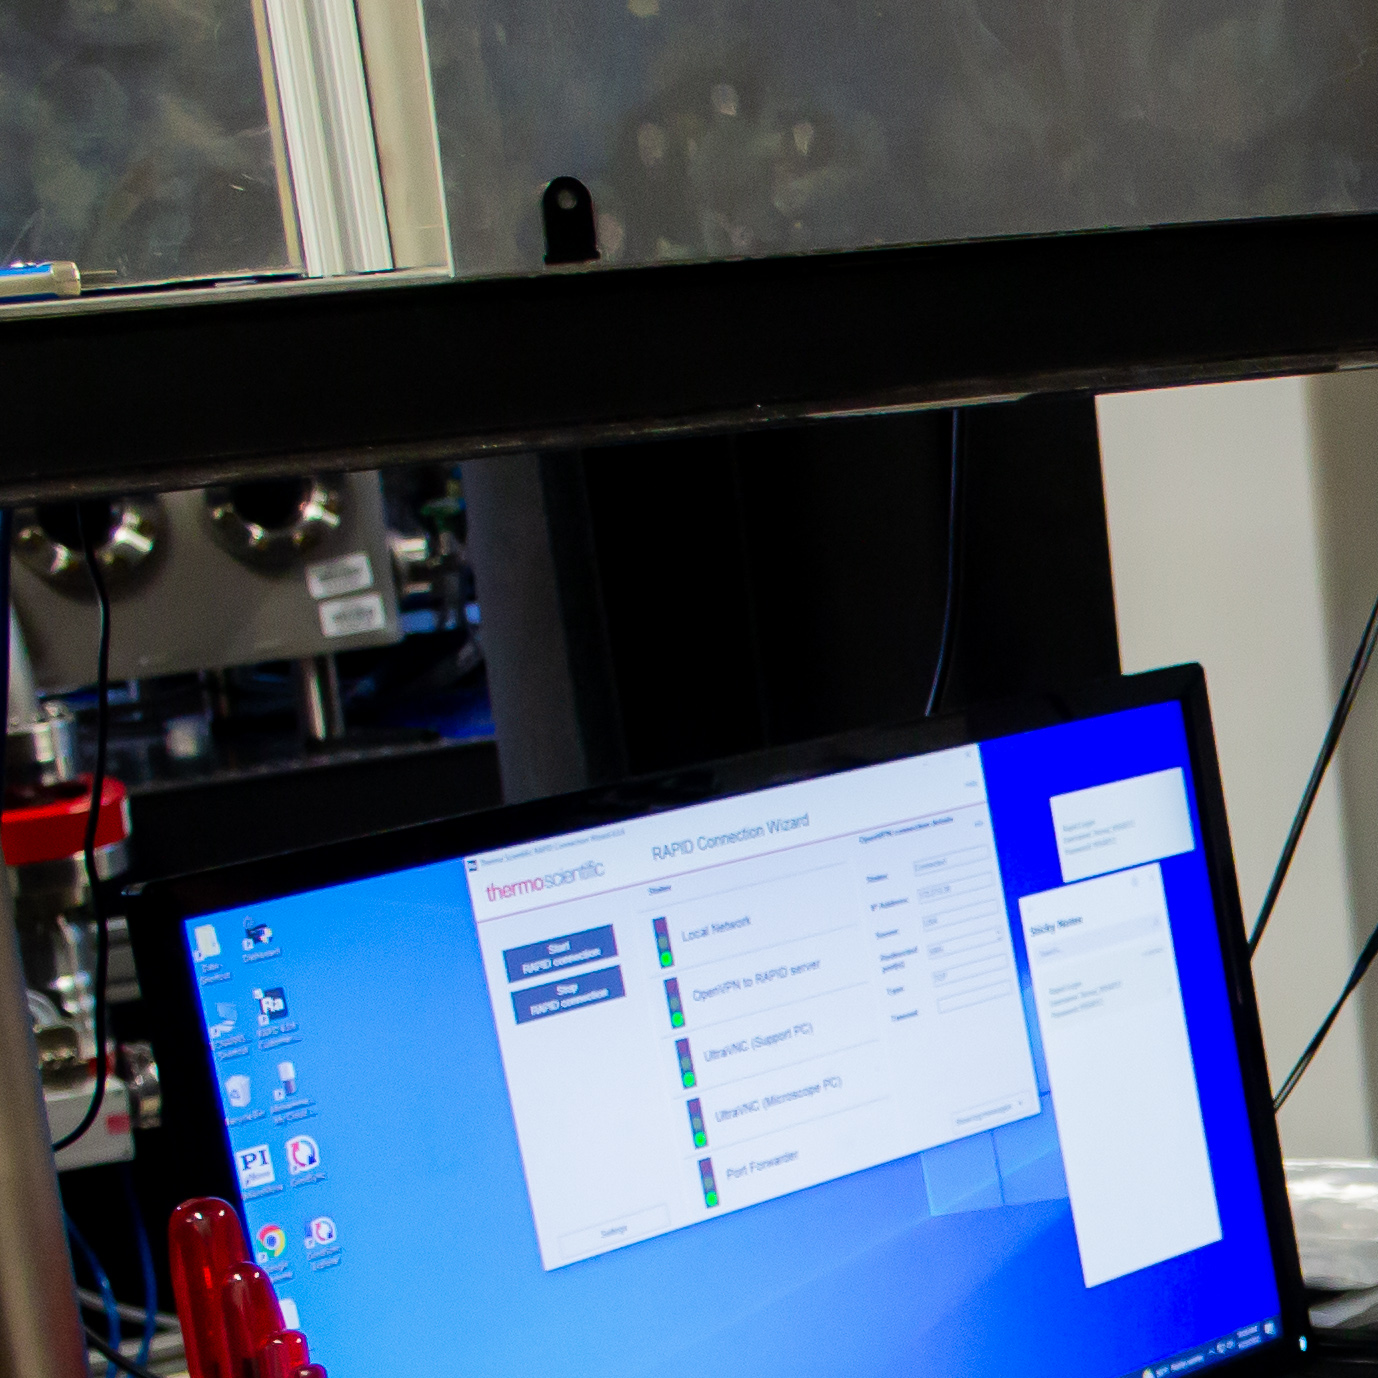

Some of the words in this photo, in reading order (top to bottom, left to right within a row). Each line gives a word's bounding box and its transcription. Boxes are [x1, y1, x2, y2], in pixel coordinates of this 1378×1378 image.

[652, 840, 695, 861] RAPID
[697, 825, 766, 852] Connection
[767, 812, 810, 835] Wizard
[682, 924, 709, 943] Local
[711, 915, 752, 936] Network
[692, 977, 741, 1003] OpenVPN
[742, 976, 754, 989] to
[755, 966, 788, 983] RAPID
[793, 1022, 815, 1037] PC)
[823, 1076, 844, 1090] PC)
[241, 1150, 270, 1172] PI
[726, 1165, 748, 1180] Port
[749, 1151, 799, 1174] Forwarder
